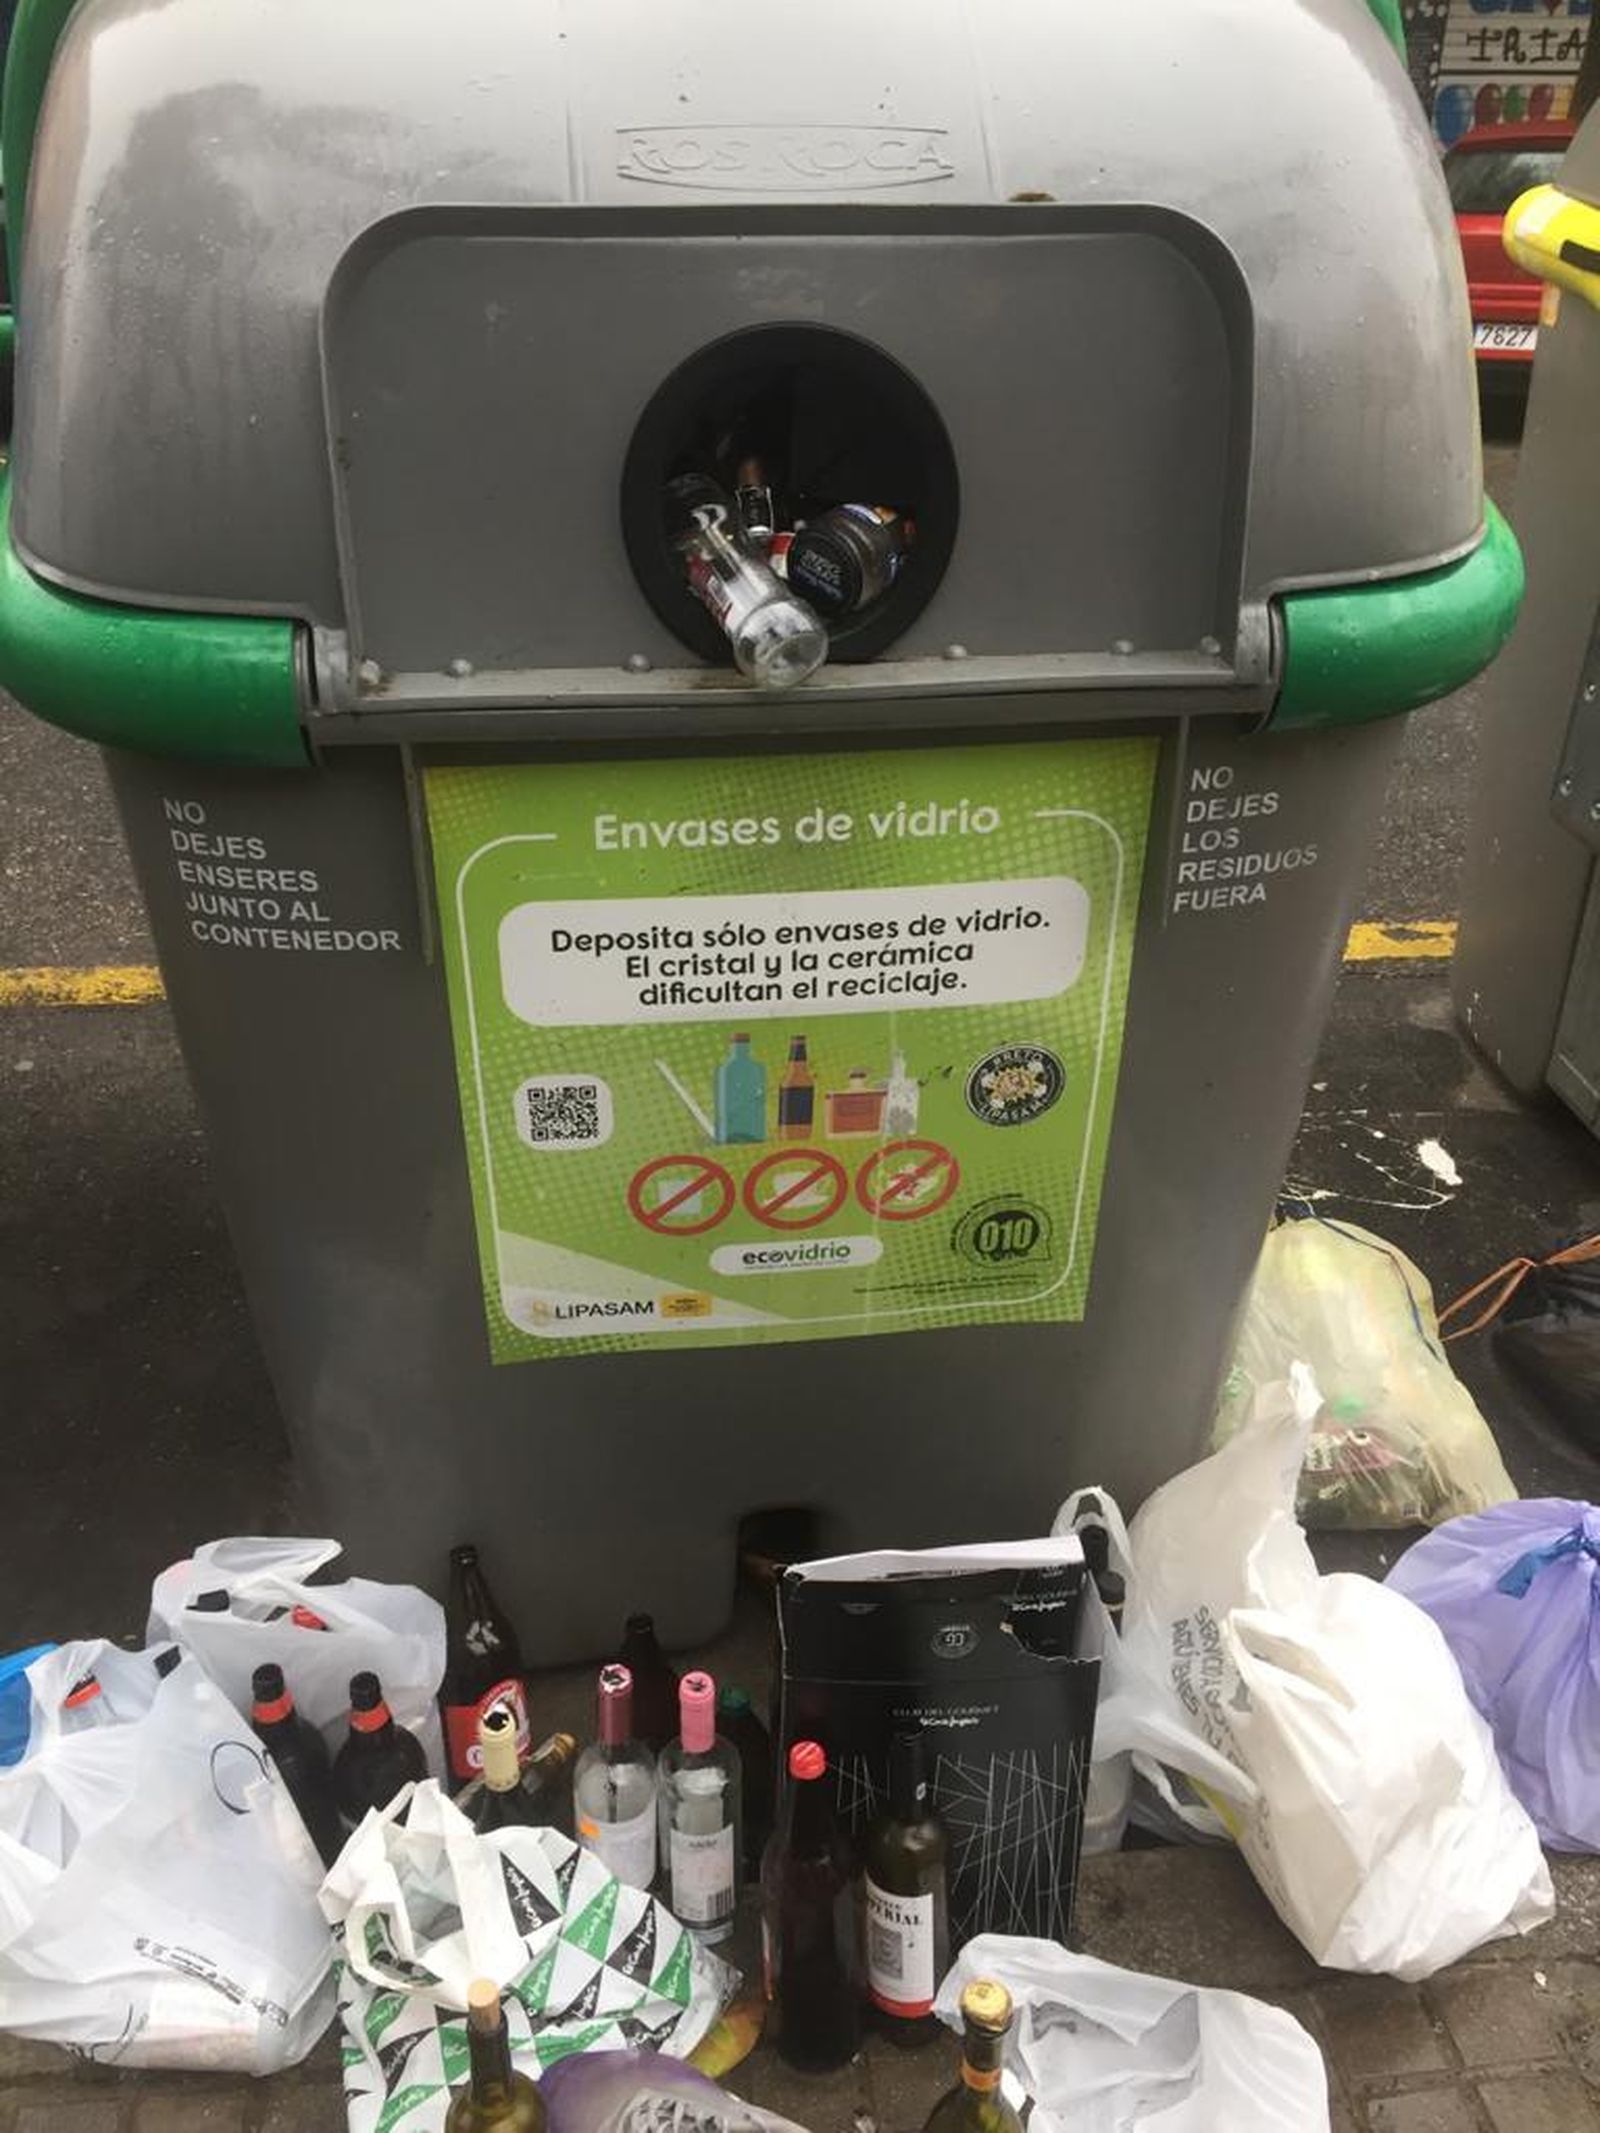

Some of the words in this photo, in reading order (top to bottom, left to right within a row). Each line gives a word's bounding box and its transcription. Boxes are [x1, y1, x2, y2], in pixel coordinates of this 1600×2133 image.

[1190, 765, 1235, 792] NO
[163, 798, 207, 825] NO
[1186, 792, 1280, 823] DEJES
[593, 813, 781, 851] Envases
[793, 807, 854, 844] de
[868, 798, 1001, 839] vidrio
[1183, 827, 1241, 853] LOS
[171, 828, 267, 860] DEJES
[178, 860, 320, 893] ENSERES
[1178, 843, 1318, 884] RESIDUOS
[186, 890, 281, 920] JUNTO
[290, 900, 331, 922] AL
[1173, 882, 1267, 913] FUERA
[191, 920, 401, 951] CONTENEDOR
[551, 926, 694, 957] Deposita
[703, 921, 766, 948] sólo
[775, 920, 899, 945] envases
[908, 914, 947, 937] de
[956, 906, 1051, 933] vidrio.
[626, 955, 650, 978] El
[659, 952, 755, 977] cristal
[764, 955, 782, 978] y
[791, 949, 818, 972] la
[828, 942, 974, 970] cerámica
[639, 980, 782, 1005] dificultan
[792, 976, 818, 999] el
[826, 967, 967, 998] reciclaje.
[980, 1218, 1033, 1252] 010
[742, 1241, 851, 1265] ecovidrio
[555, 1301, 654, 1319] LIPASAM
